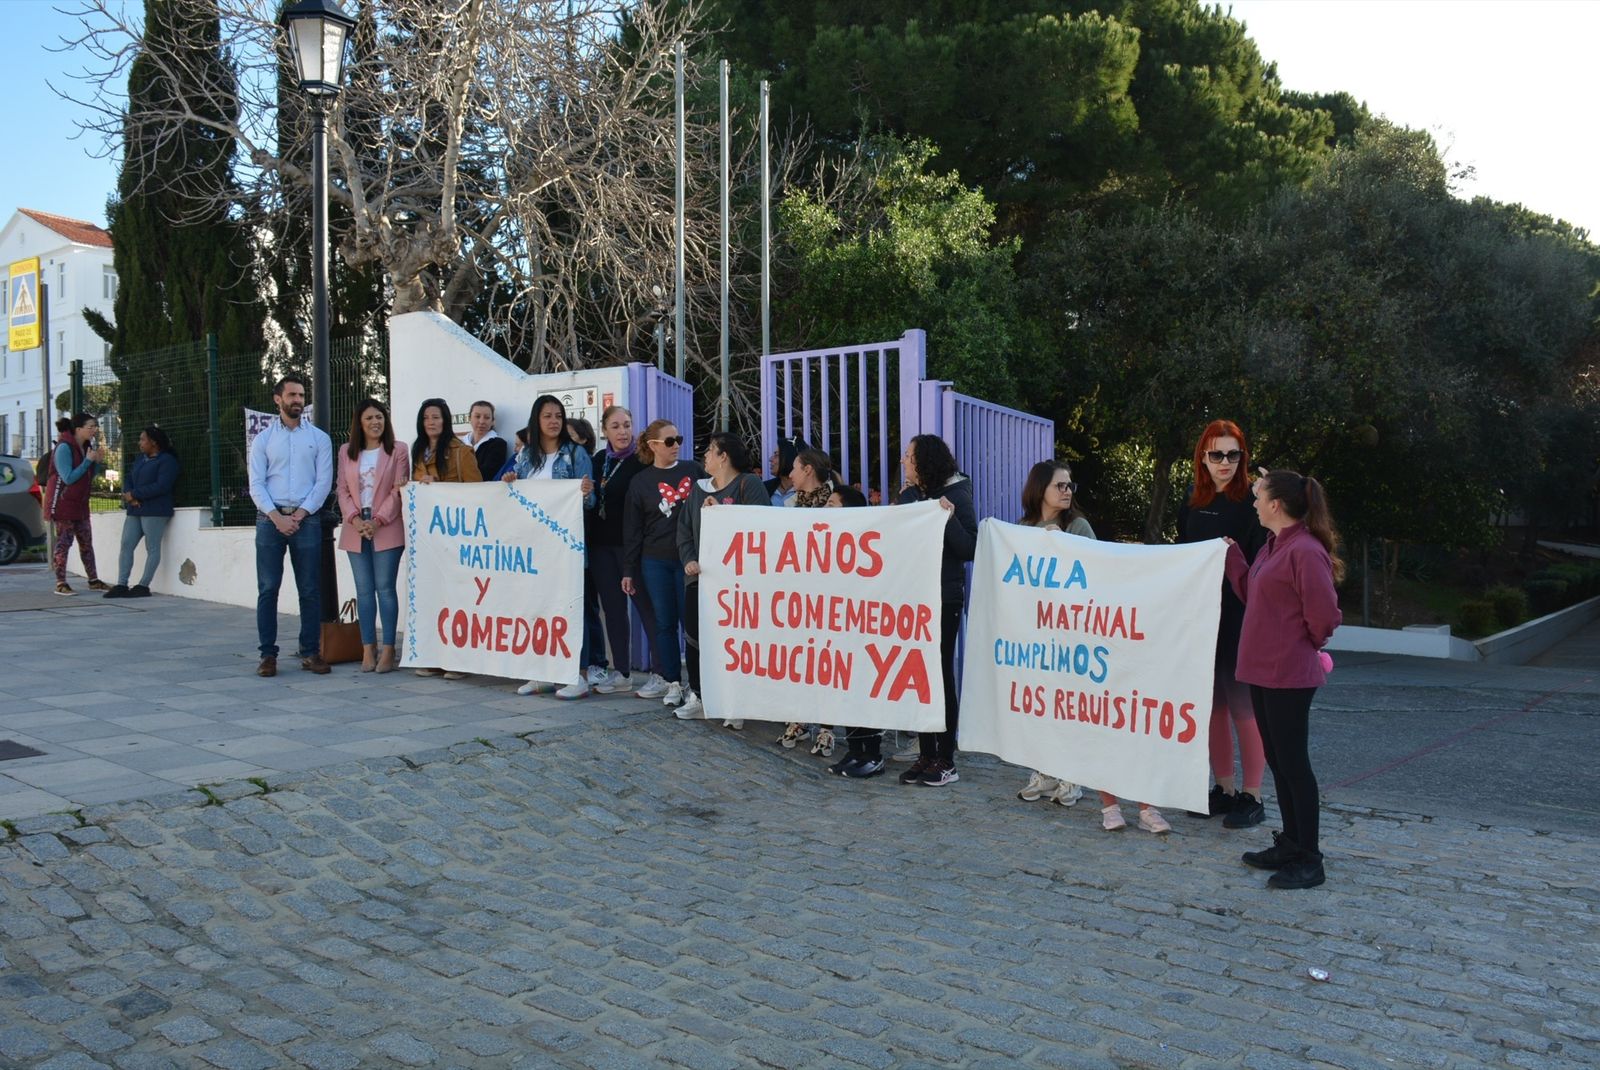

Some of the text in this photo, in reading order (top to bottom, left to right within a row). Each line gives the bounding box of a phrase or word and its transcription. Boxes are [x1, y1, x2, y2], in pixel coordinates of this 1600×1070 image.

[429, 505, 488, 538] AULA
[459, 540, 538, 575] MATINAL
[722, 523, 883, 578] 14 AÑOS
[1002, 553, 1088, 590] AULA
[474, 576, 491, 606] Y
[717, 583, 932, 642] SIN COMEMEDOR
[437, 607, 571, 659] COMEDOR
[724, 637, 931, 704] SOLUCIÓN YA
[994, 638, 1110, 684] CUMPLIMOS
[1010, 681, 1197, 744] LOS REQUISITOS
